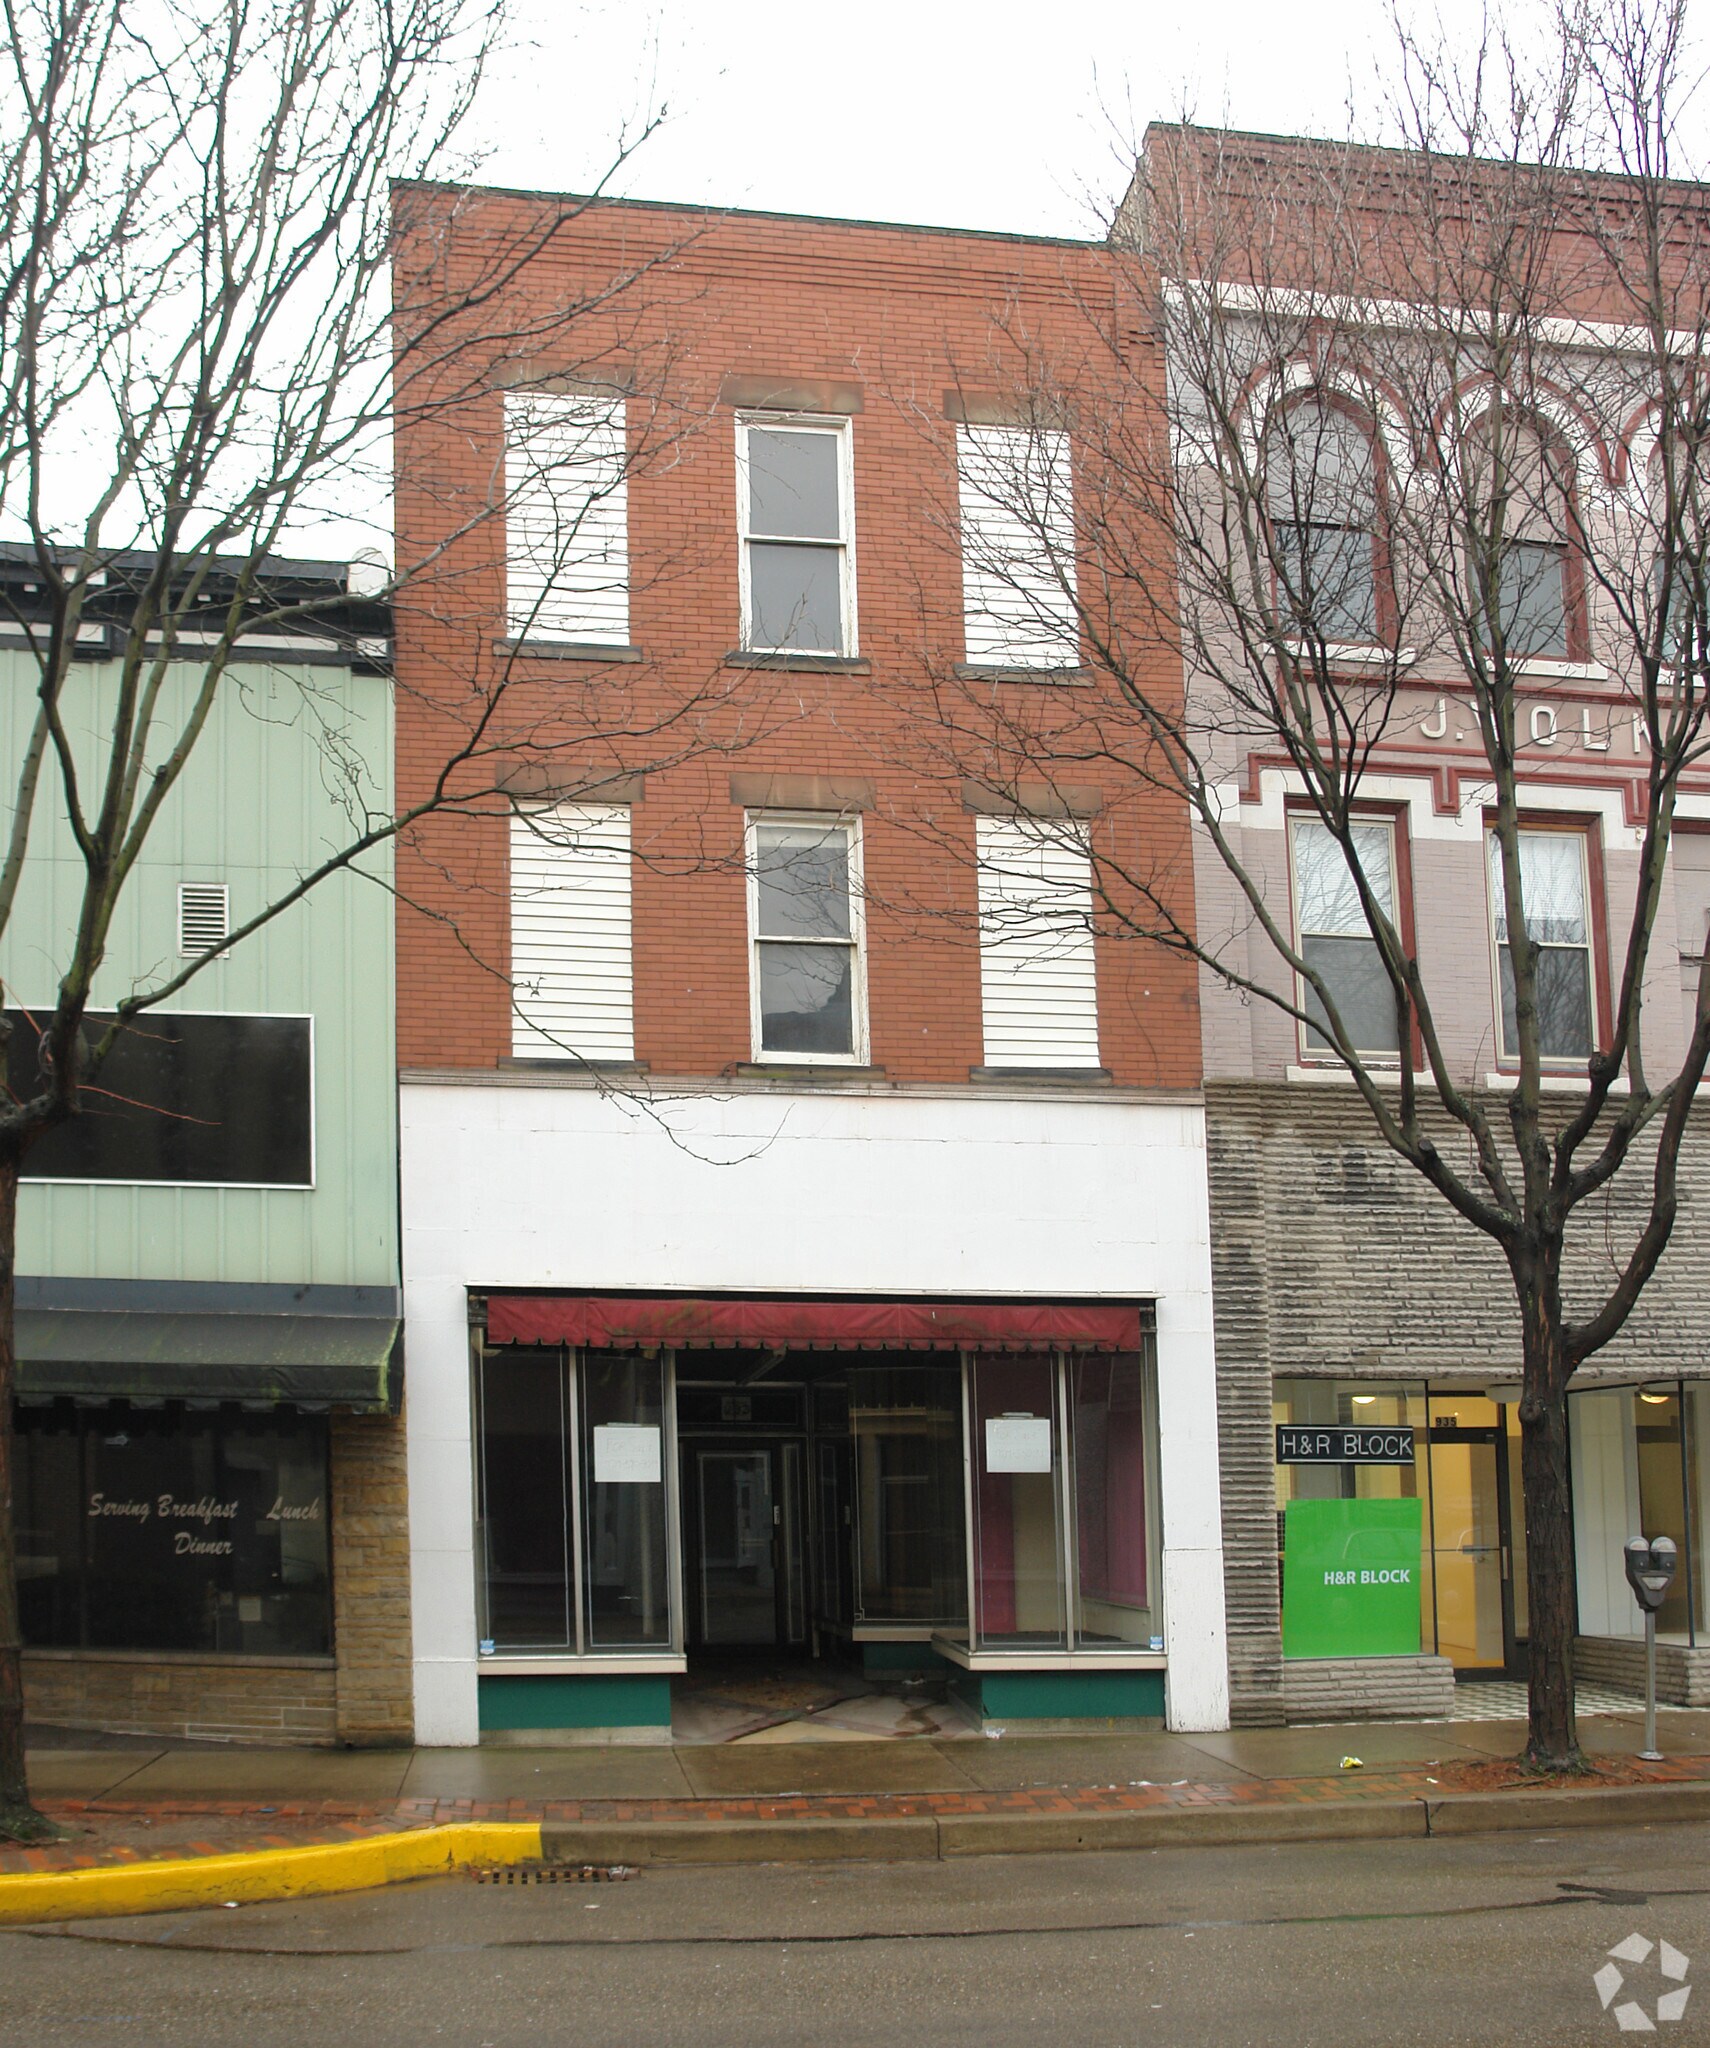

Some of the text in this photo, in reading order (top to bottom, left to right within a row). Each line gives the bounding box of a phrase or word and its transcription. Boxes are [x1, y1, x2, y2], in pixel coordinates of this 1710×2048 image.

[1435, 1417, 1457, 1427] 935
[1282, 1434, 1413, 1456] H&R BLOCK
[88, 1493, 320, 1525] Serving Breakfast Lunch
[174, 1532, 235, 1555] Dinner
[1324, 1569, 1410, 1585] H&R BLOCK
